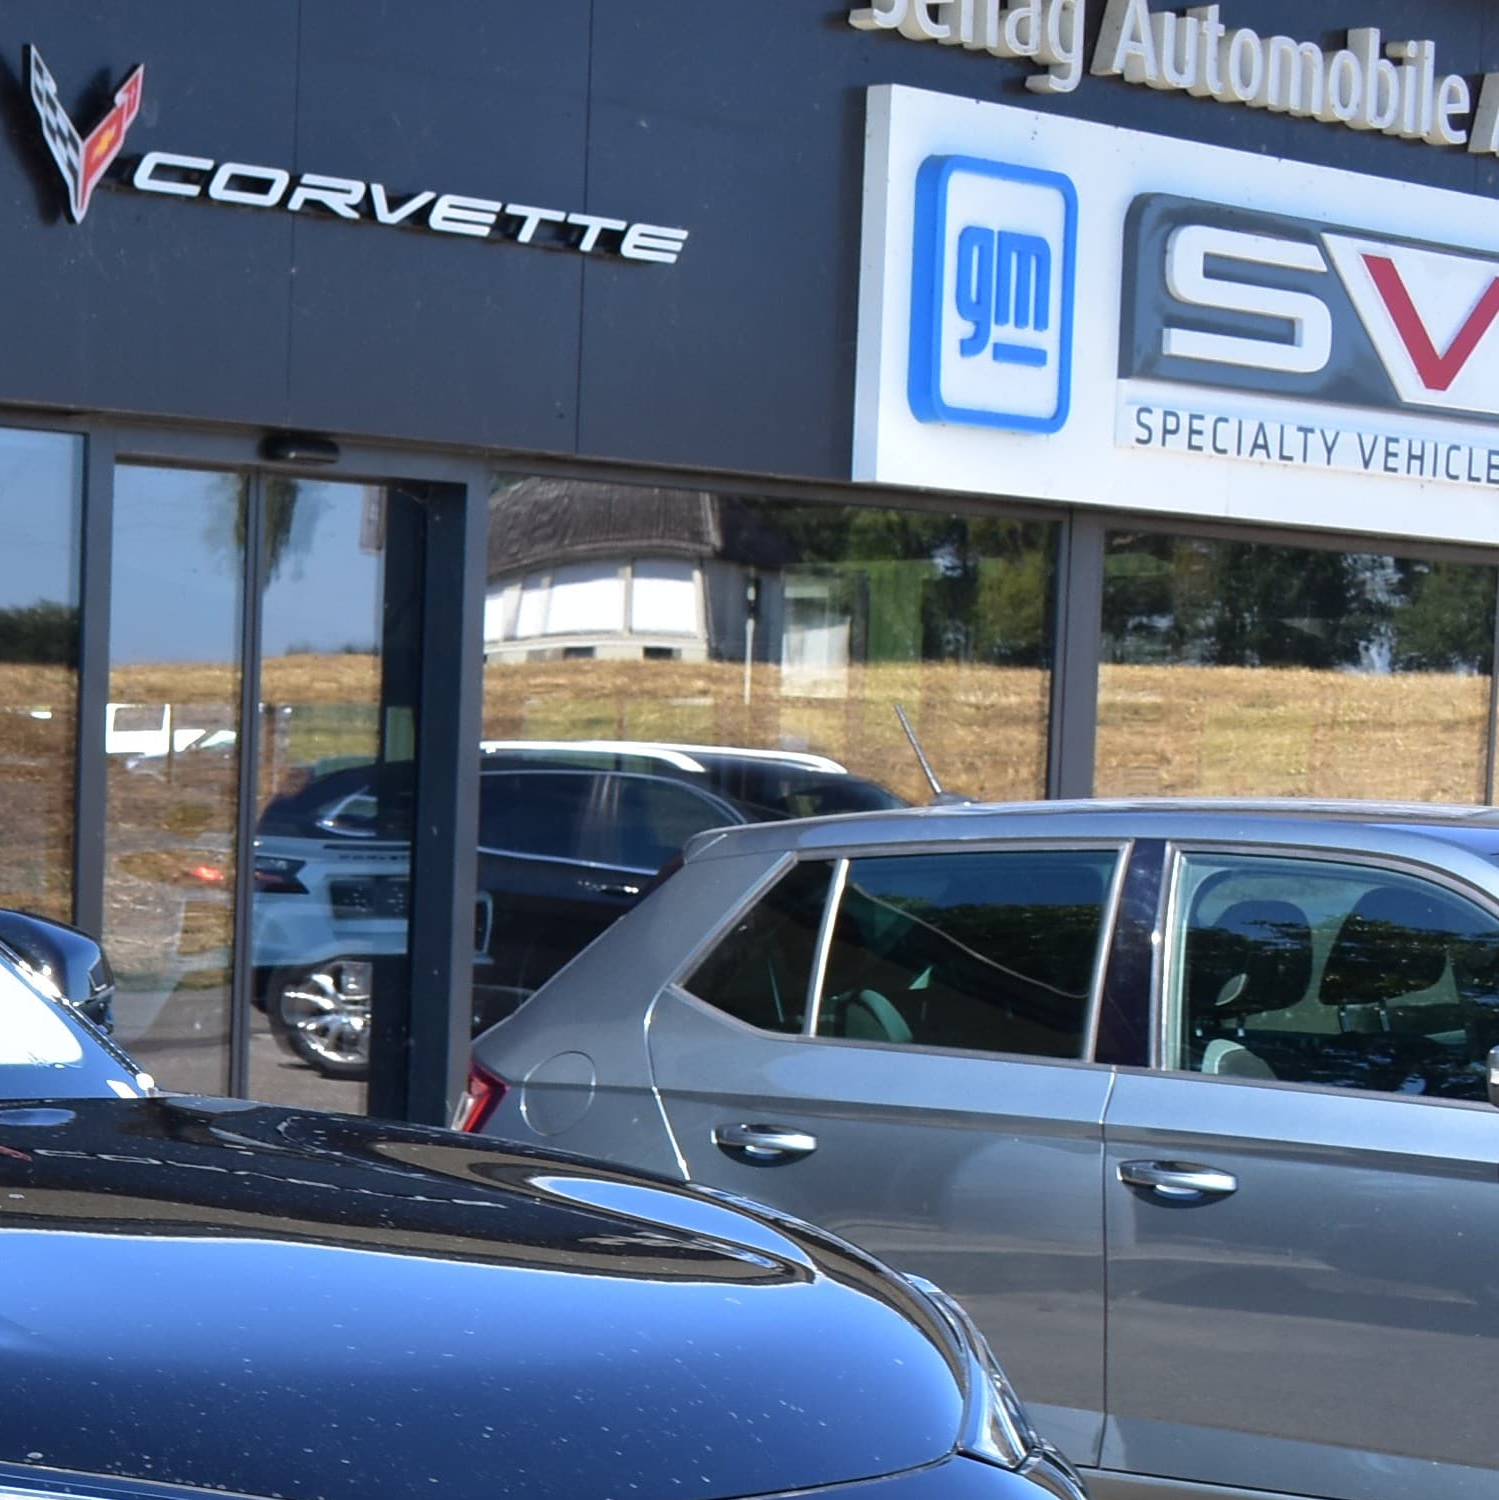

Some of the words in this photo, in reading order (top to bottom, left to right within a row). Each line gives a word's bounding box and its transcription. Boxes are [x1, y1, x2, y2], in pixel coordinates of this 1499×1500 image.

[1093, 0, 1471, 146] Automobile
[133, 151, 689, 264] CORVETTE
[955, 225, 1052, 362] gm
[1135, 406, 1341, 467] SPECIALTY
[1357, 431, 1499, 486] VEHICLE
